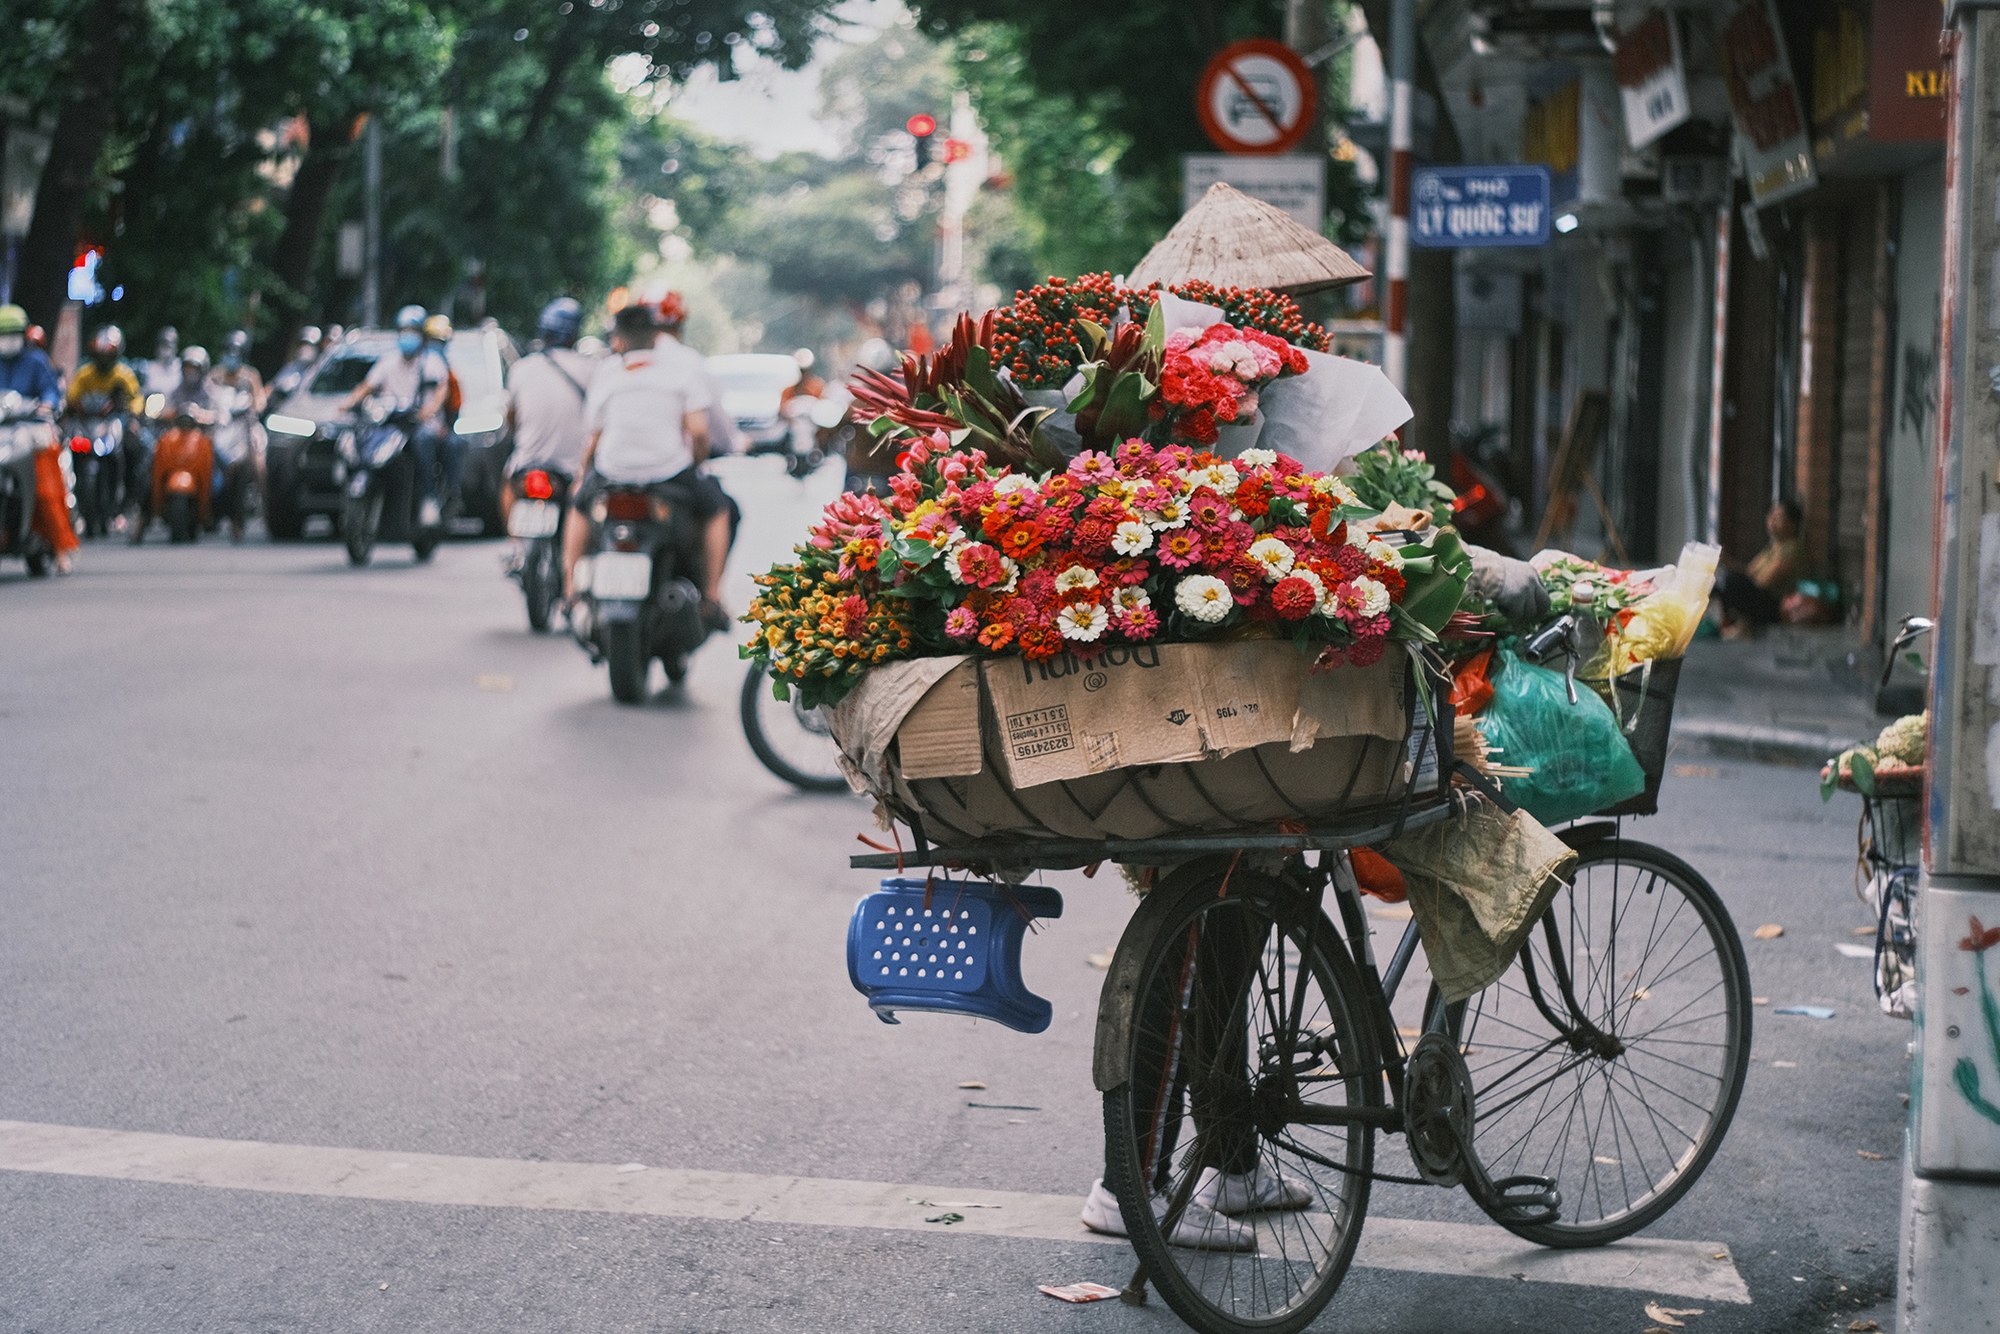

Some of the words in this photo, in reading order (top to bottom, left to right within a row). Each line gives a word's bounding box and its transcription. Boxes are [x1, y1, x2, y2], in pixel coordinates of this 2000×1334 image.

[1034, 713, 1040, 722] x
[1042, 712, 1048, 722] L
[1050, 708, 1064, 720] 3.5
[1173, 711, 1185, 722] UP
[1026, 715, 1031, 725] 4
[1040, 728, 1044, 736] 4
[1050, 725, 1056, 734] L
[1057, 722, 1068, 732] 3.5
[1012, 729, 1038, 740] Pouches
[1018, 738, 1068, 756] 82324195
